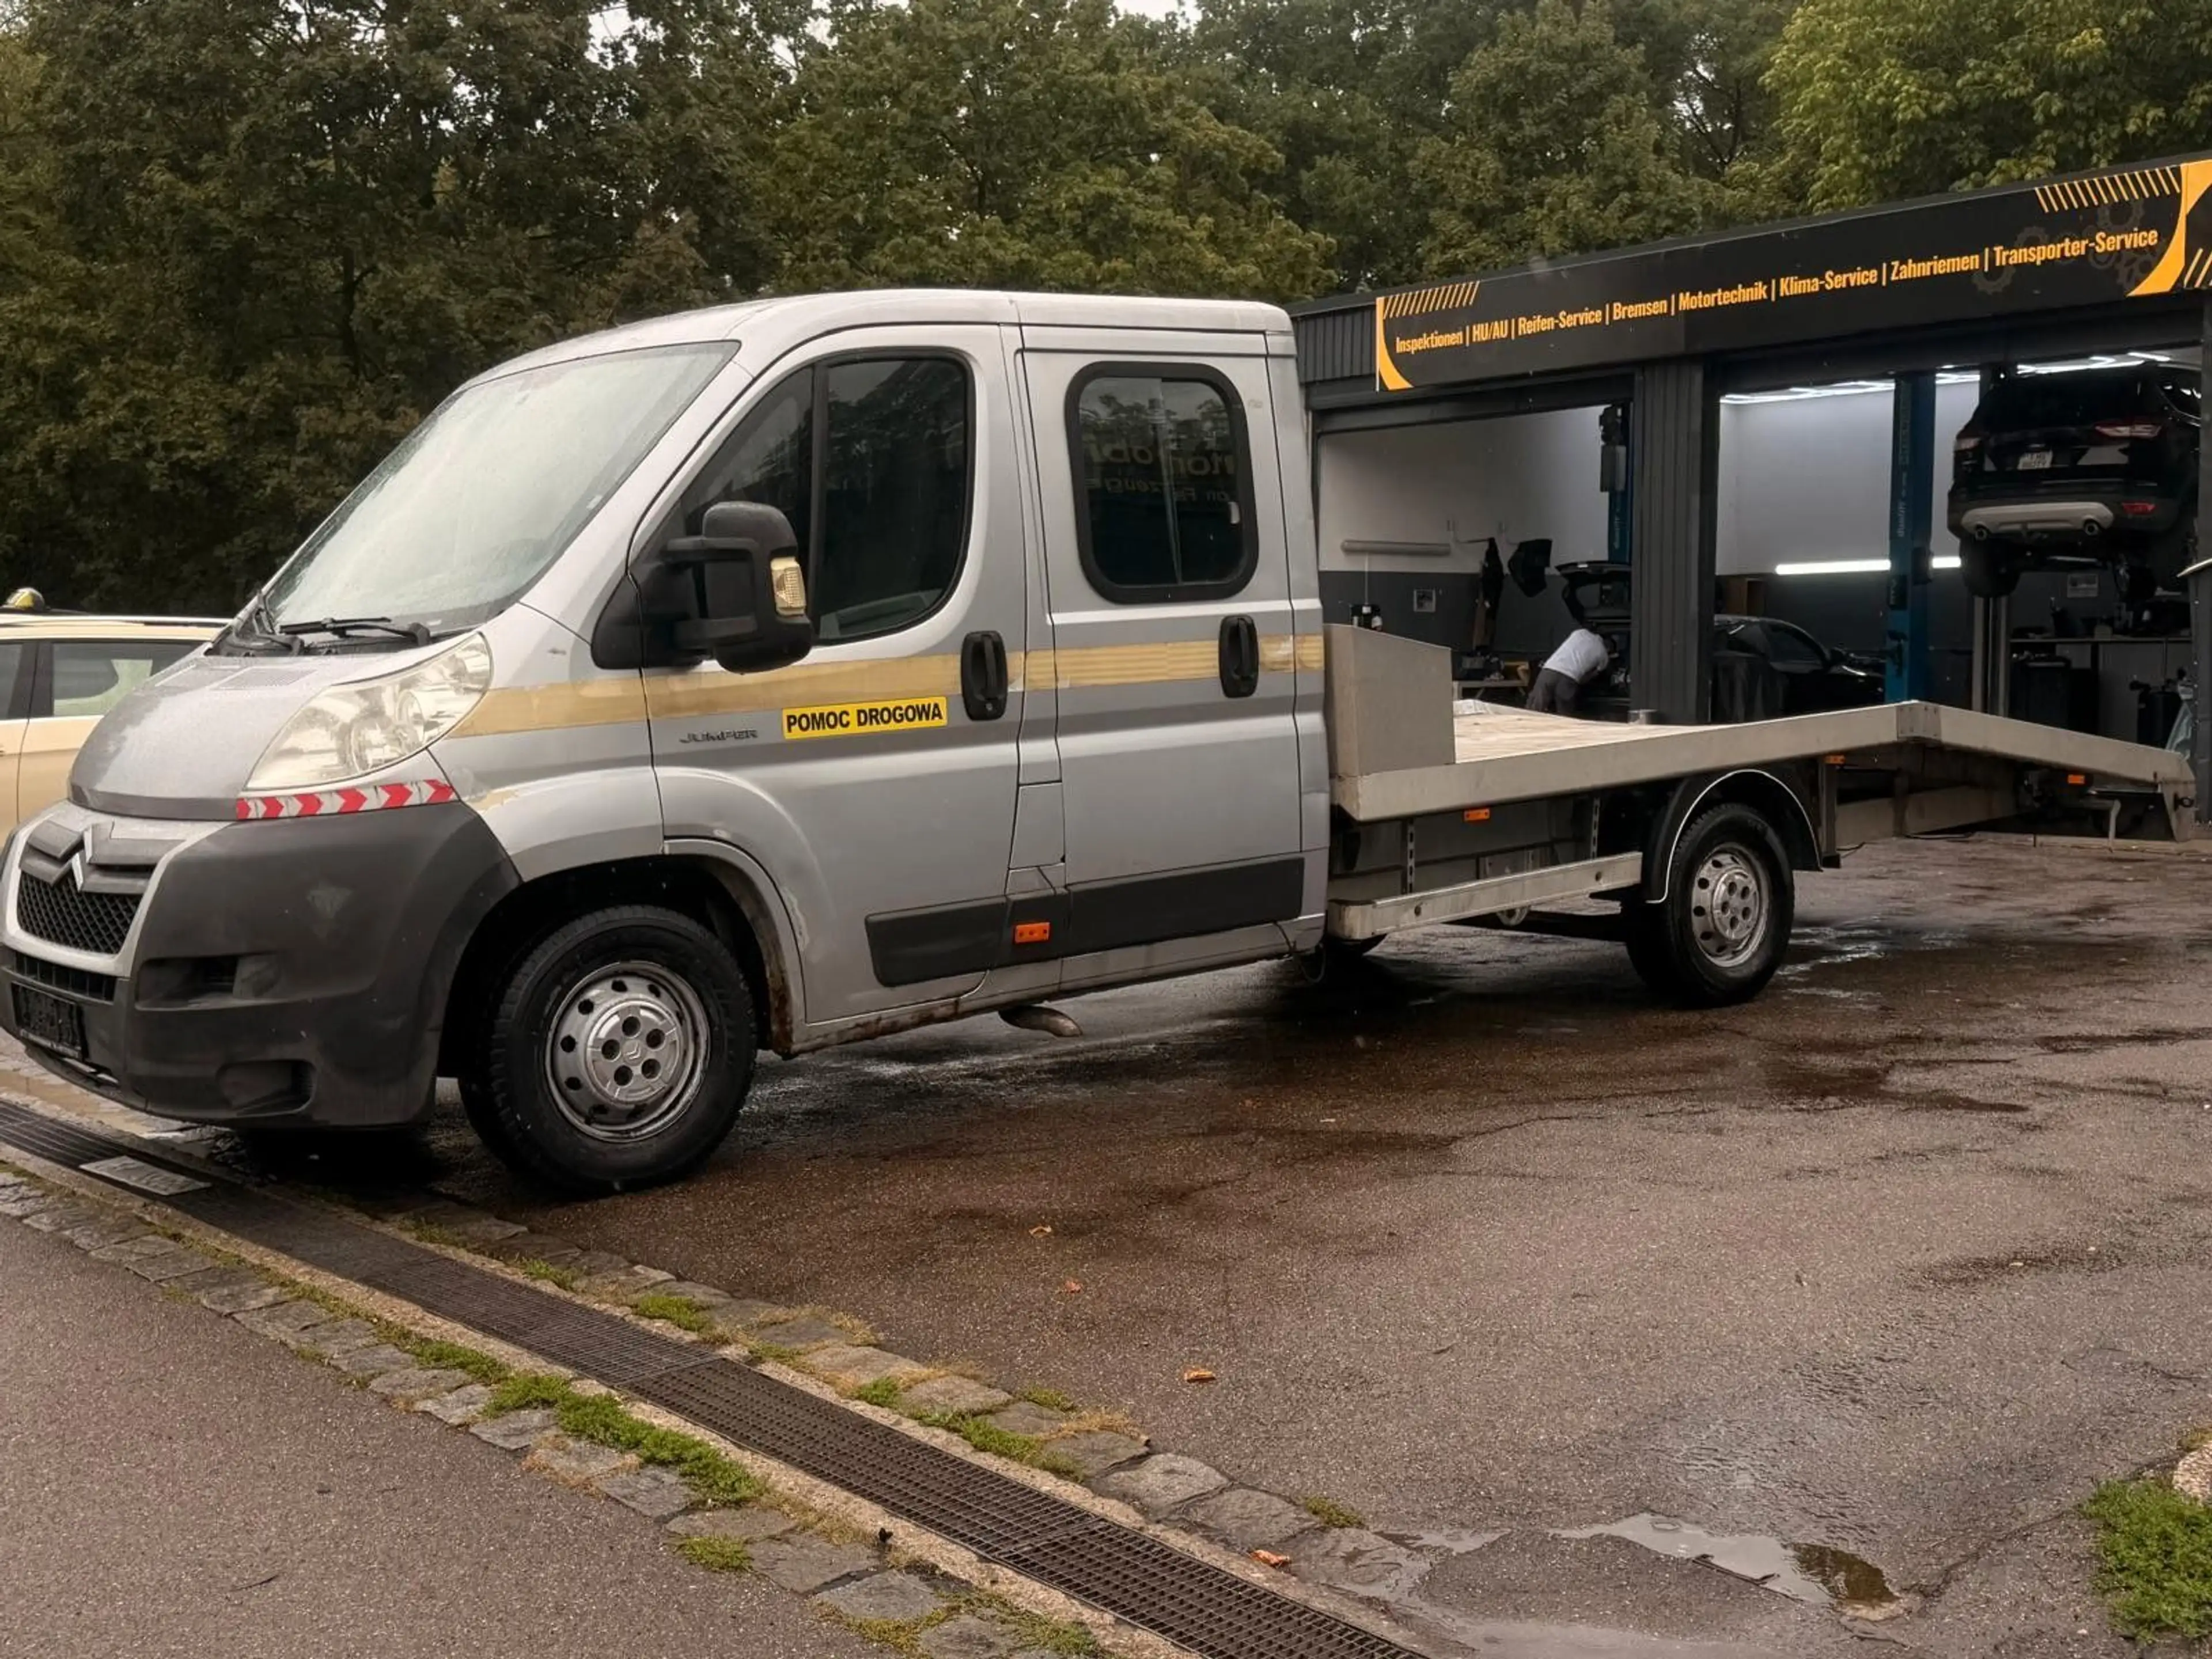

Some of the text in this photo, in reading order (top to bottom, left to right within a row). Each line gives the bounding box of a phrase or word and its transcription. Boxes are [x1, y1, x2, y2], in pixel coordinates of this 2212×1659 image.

[1395, 227, 2158, 354] Inspektionen HU/AU Reifen-Service Bremsen Motortechnik Klima-Service Zahnriemen Transporter-Service
[786, 703, 943, 733] POMOC DROGOWA
